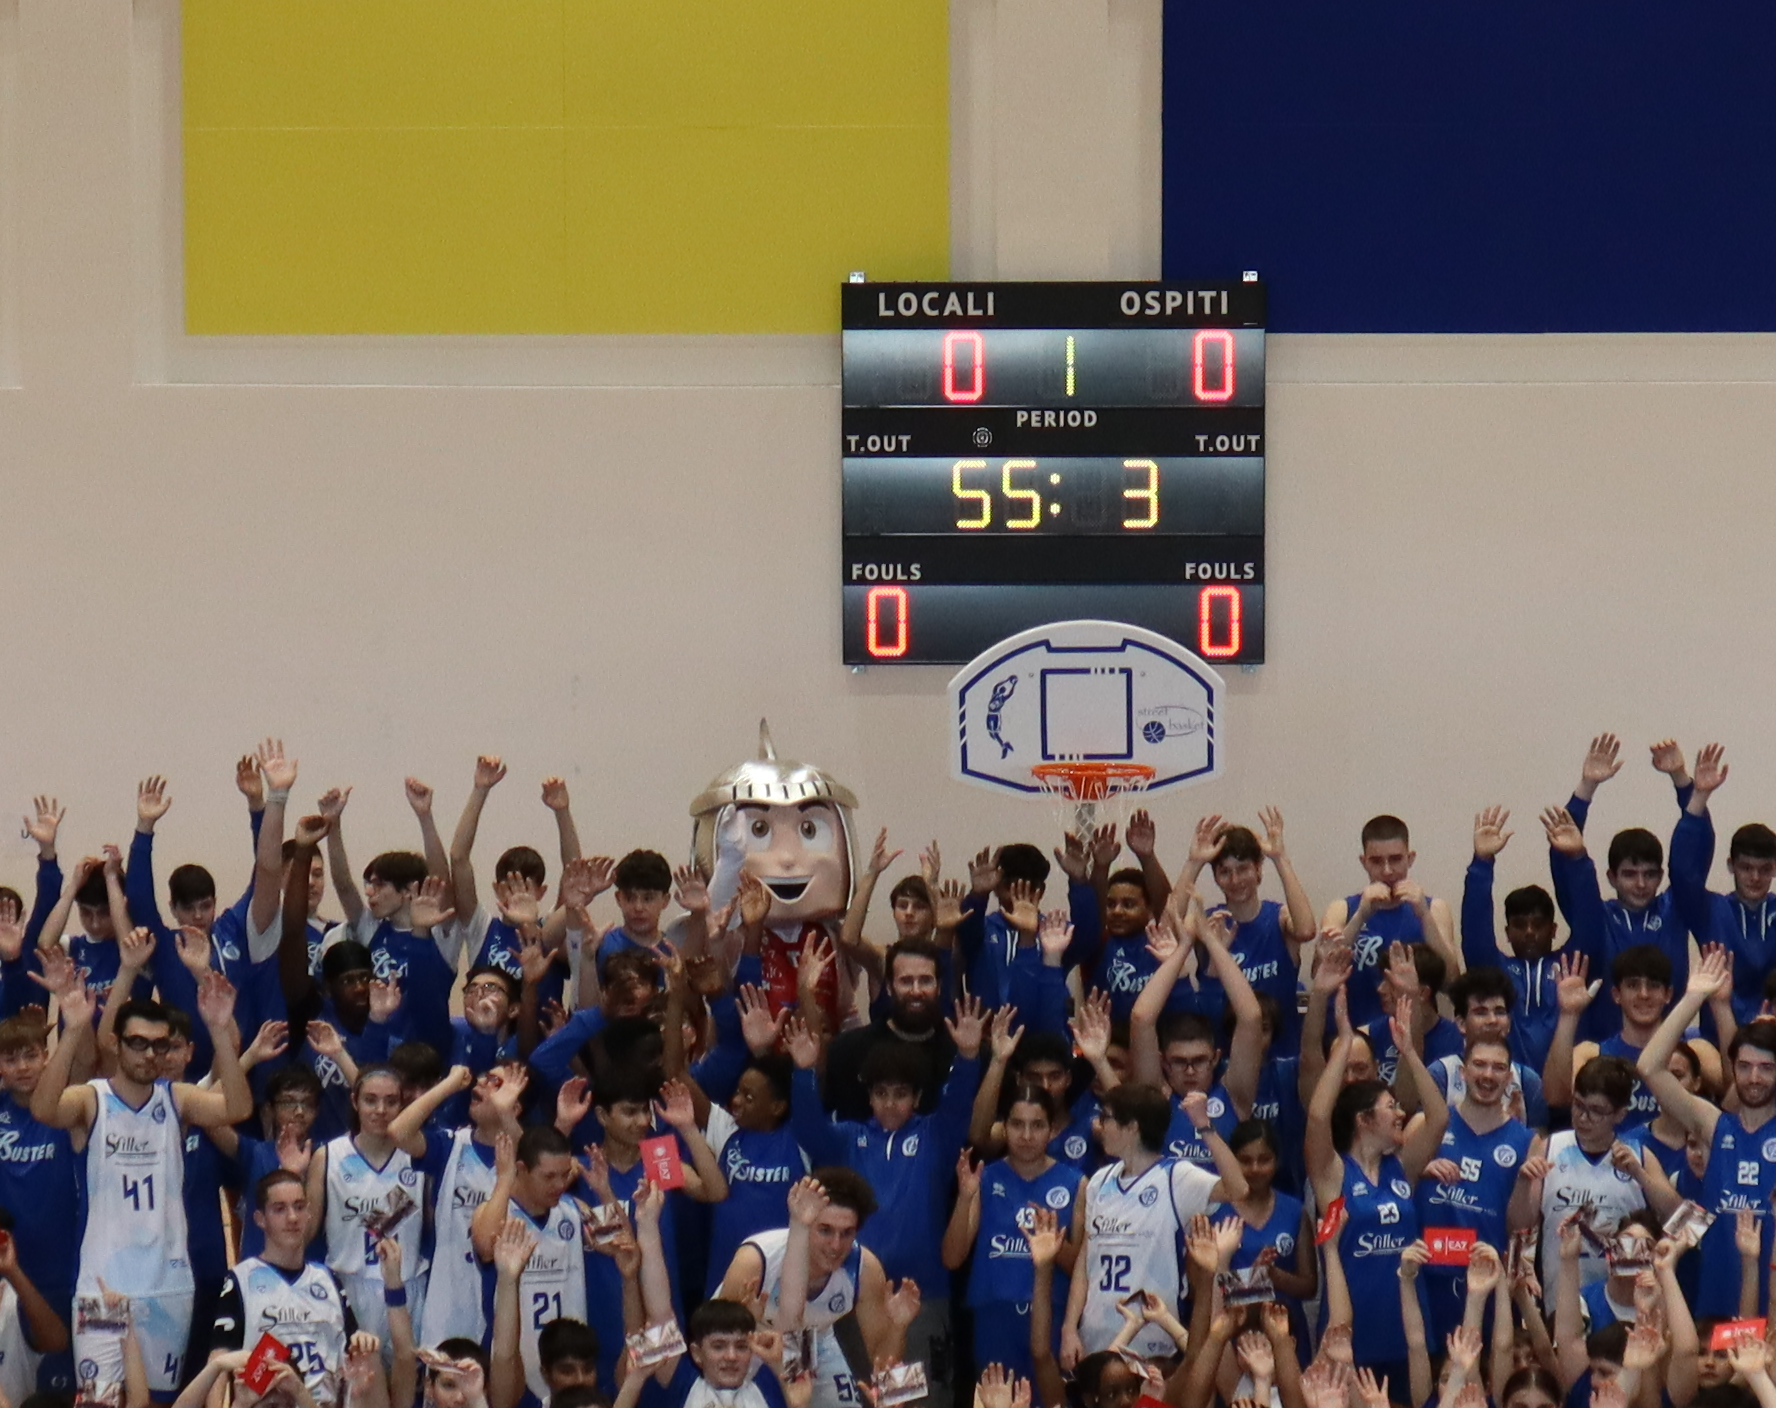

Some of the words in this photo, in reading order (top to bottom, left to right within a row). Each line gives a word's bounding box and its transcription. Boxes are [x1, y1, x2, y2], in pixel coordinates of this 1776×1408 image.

[878, 292, 995, 316] LOCALI
[1120, 290, 1229, 316] OSPITI
[943, 331, 984, 402] 0
[1065, 334, 1074, 397] 1
[1192, 330, 1235, 401] 0
[1016, 409, 1098, 428] PERIOD
[847, 434, 911, 452] T.OUT
[1195, 434, 1261, 452] T.OUT
[851, 562, 922, 580] FOULS
[1185, 562, 1255, 580] FOULS
[867, 585, 907, 657] 0
[1200, 584, 1241, 657] 0
[1459, 1157, 1483, 1182] 55
[1737, 1161, 1759, 1186] 22
[122, 1172, 155, 1212] 41
[1376, 1203, 1401, 1224] 23
[1448, 1241, 1468, 1252] EA7
[1099, 1254, 1132, 1293] 32
[532, 1291, 562, 1330] 21
[290, 1341, 324, 1374] 25
